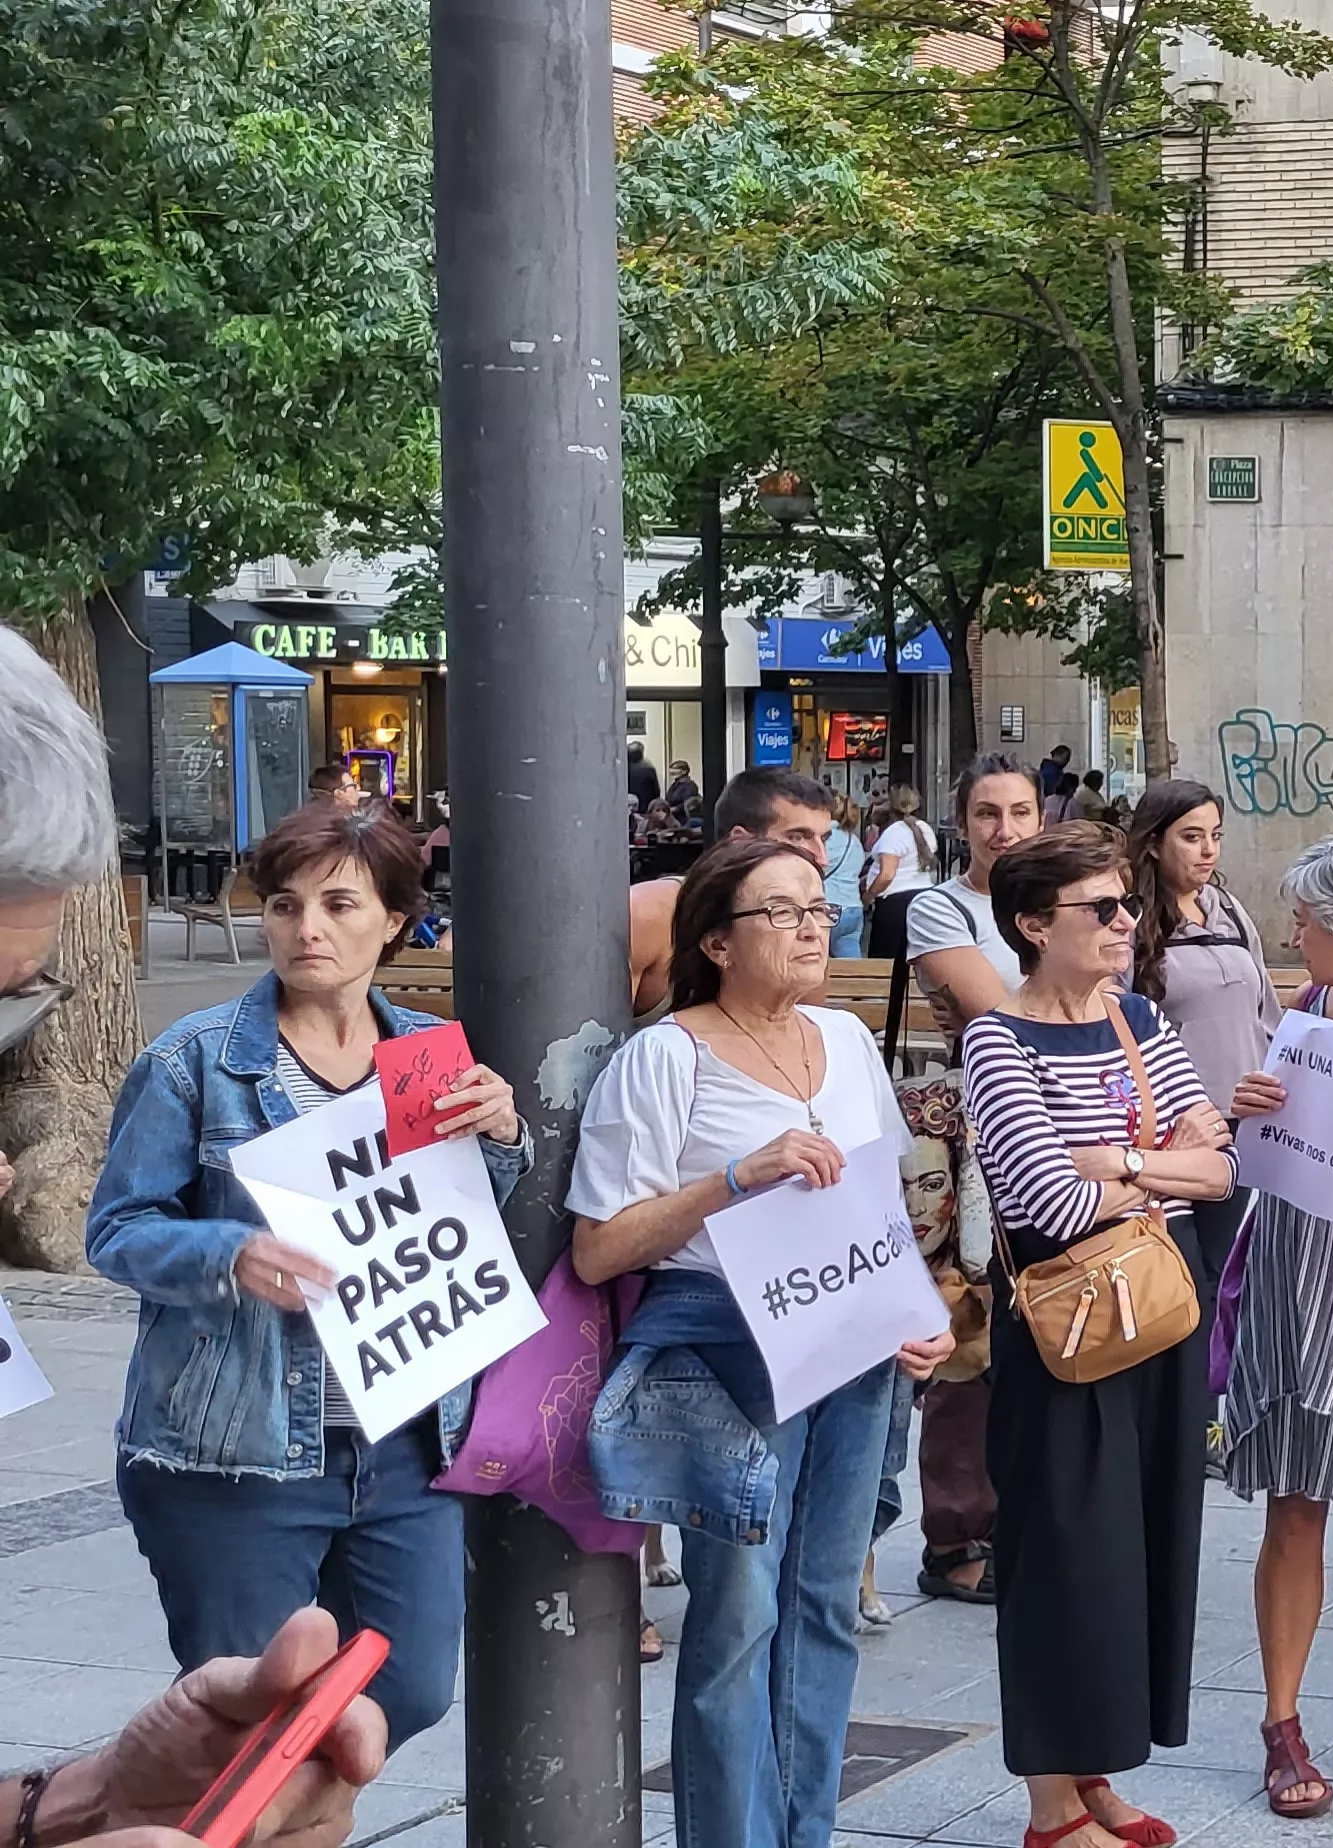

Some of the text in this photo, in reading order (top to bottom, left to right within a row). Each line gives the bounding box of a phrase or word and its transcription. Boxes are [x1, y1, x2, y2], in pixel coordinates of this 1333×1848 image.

[1052, 517, 1128, 540] ONC
[253, 623, 338, 658] CAFE
[651, 635, 697, 667] Chi
[1110, 709, 1139, 726] ncas
[758, 732, 789, 749] Viajes
[1277, 1044, 1303, 1066] #NI
[1308, 1051, 1333, 1078] UNA
[325, 1128, 393, 1192] NI
[1260, 1124, 1305, 1153] #Vivas
[1305, 1143, 1326, 1164] nos
[331, 1172, 422, 1247] UN
[335, 1216, 469, 1326] PASO
[356, 1259, 511, 1392] ATRÁS
